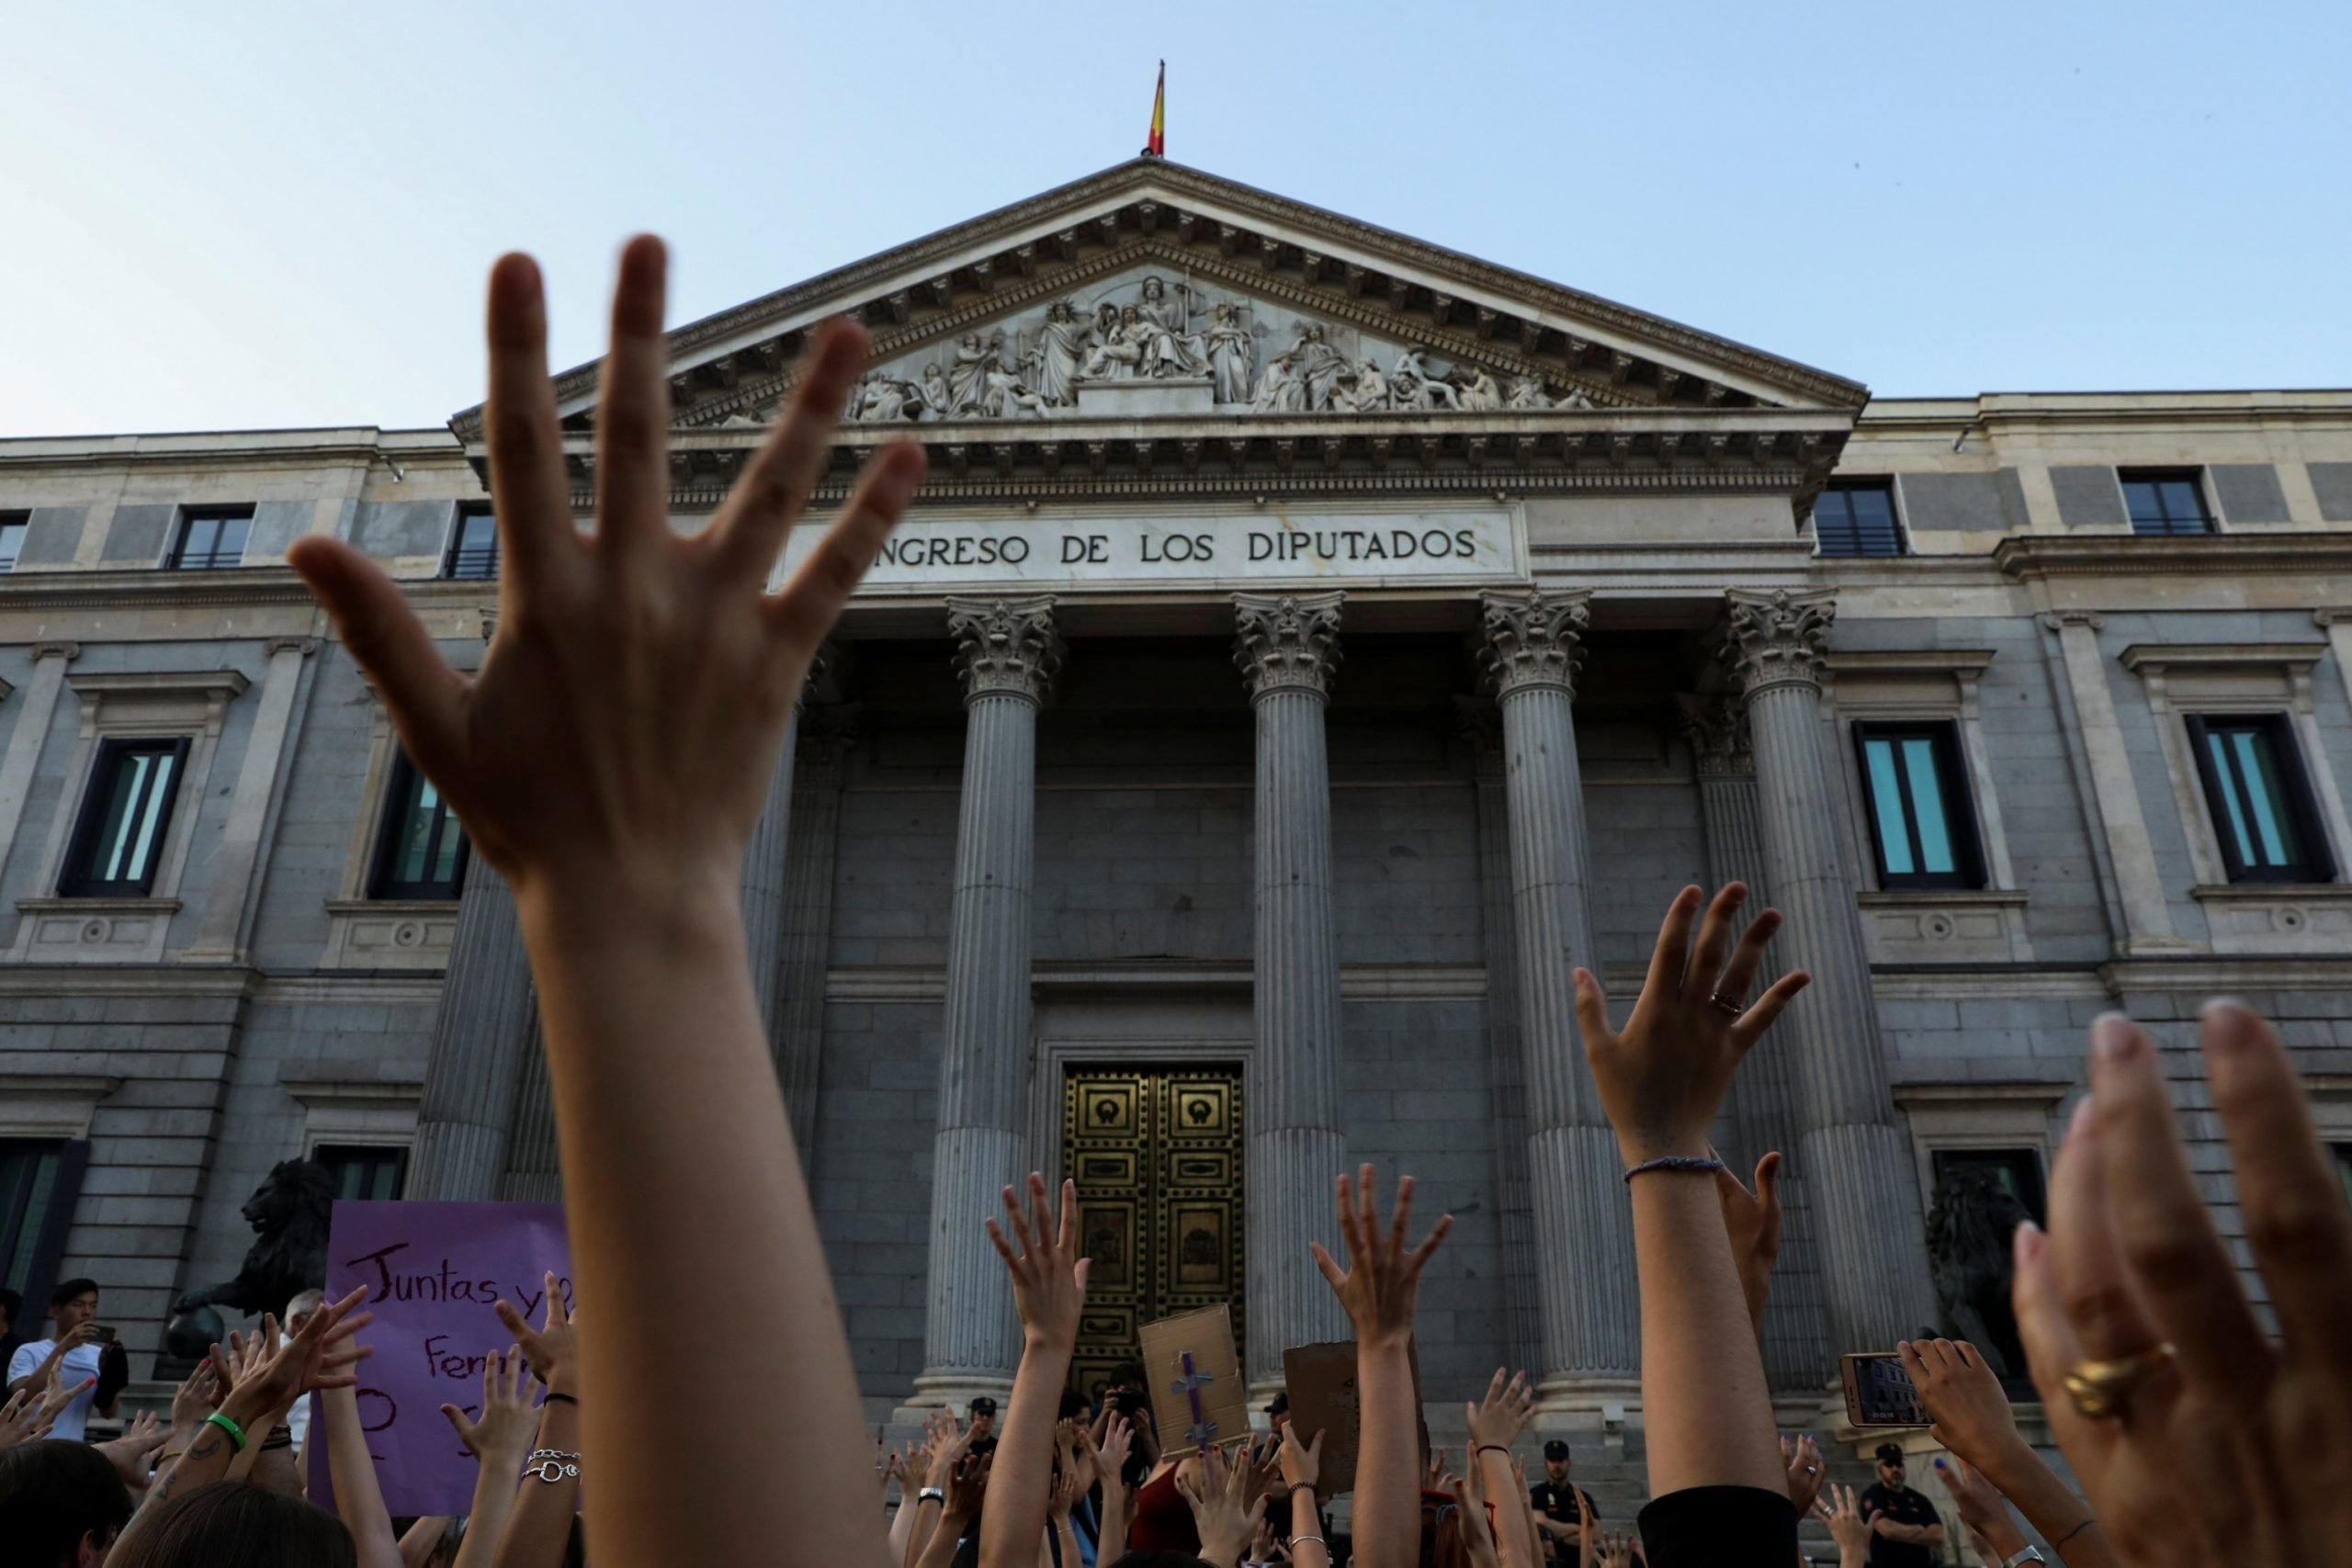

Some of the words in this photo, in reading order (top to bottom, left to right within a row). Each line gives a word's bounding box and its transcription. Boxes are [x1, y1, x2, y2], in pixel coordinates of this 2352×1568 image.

[875, 536, 1030, 567] NGRESO
[1060, 535, 1108, 564] DE
[1140, 534, 1214, 562] LOS
[1248, 529, 1476, 560] DIPUTADOS
[346, 1242, 499, 1304] Juntas
